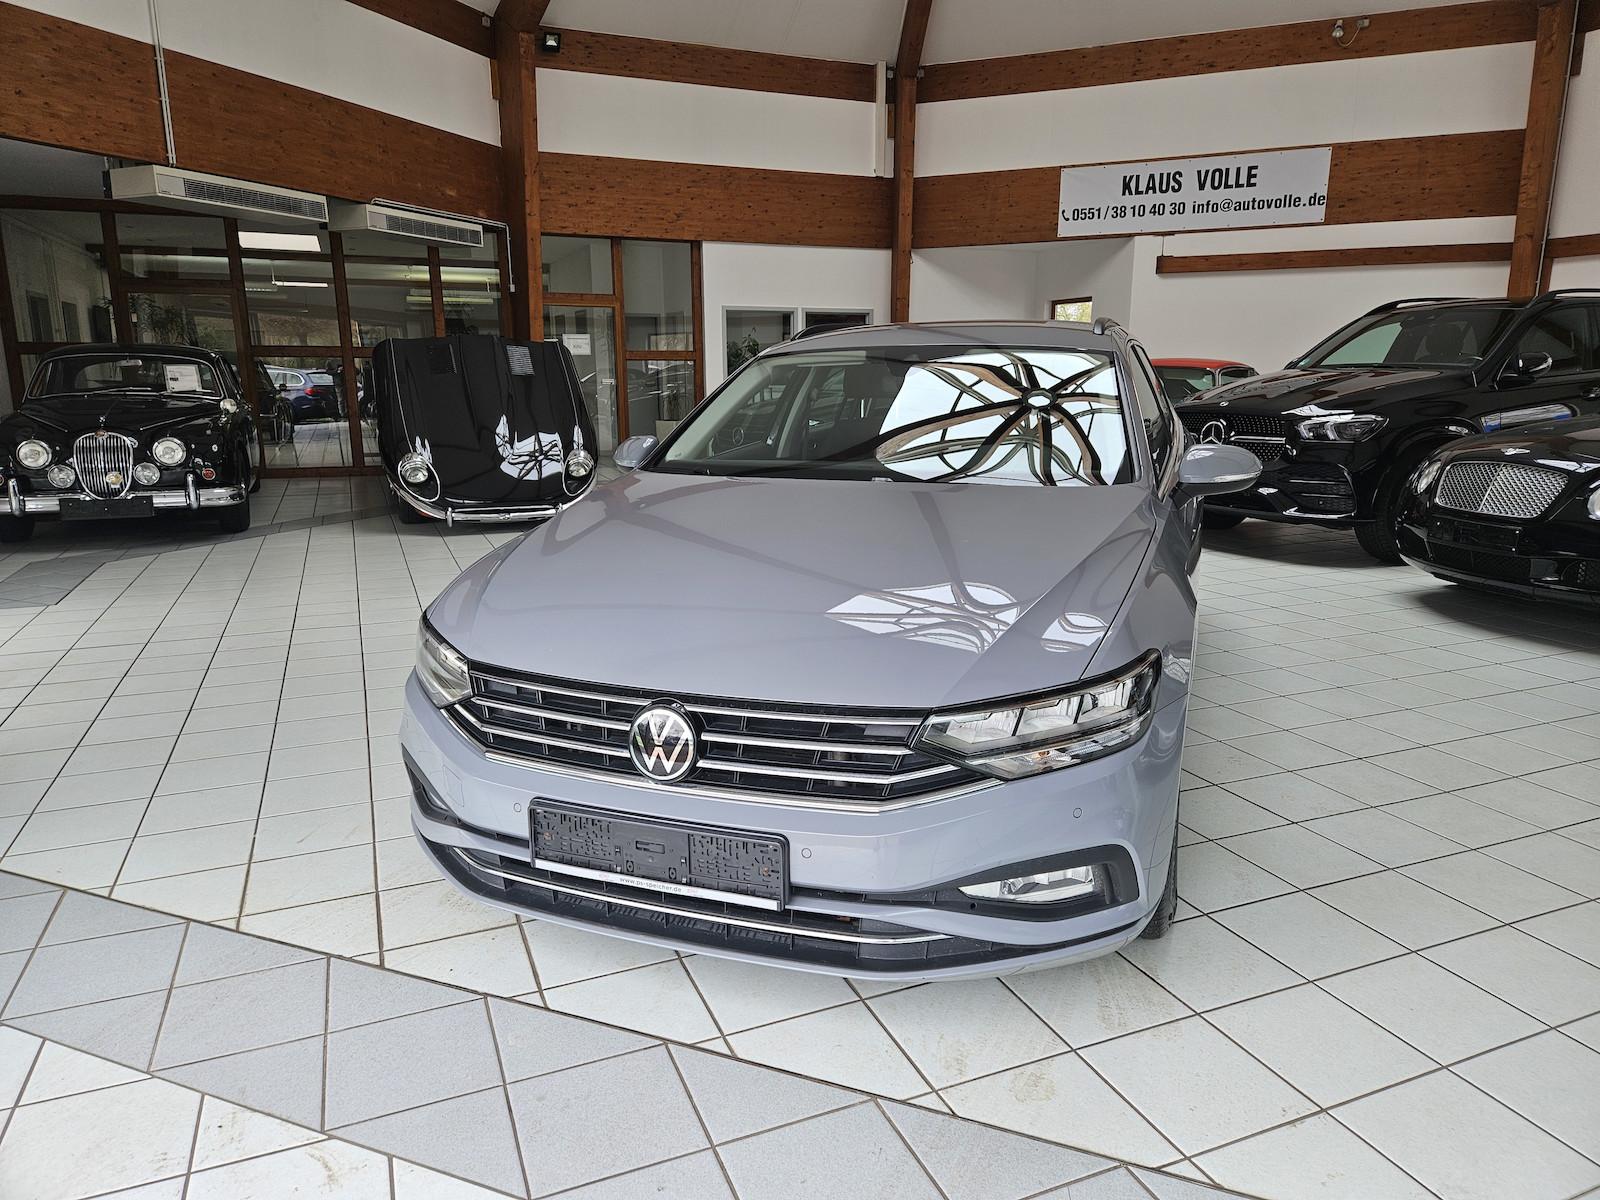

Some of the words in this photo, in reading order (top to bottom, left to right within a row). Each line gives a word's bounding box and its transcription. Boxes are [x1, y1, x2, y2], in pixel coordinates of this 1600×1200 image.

[1121, 170, 1183, 196] KLAUS
[1196, 165, 1259, 191] VOLLE
[1130, 204, 1146, 218] 10
[1149, 203, 1166, 216] 40
[1169, 201, 1186, 215] 30
[1191, 192, 1326, 214] info@autovolle.de
[631, 710, 693, 777] VW
